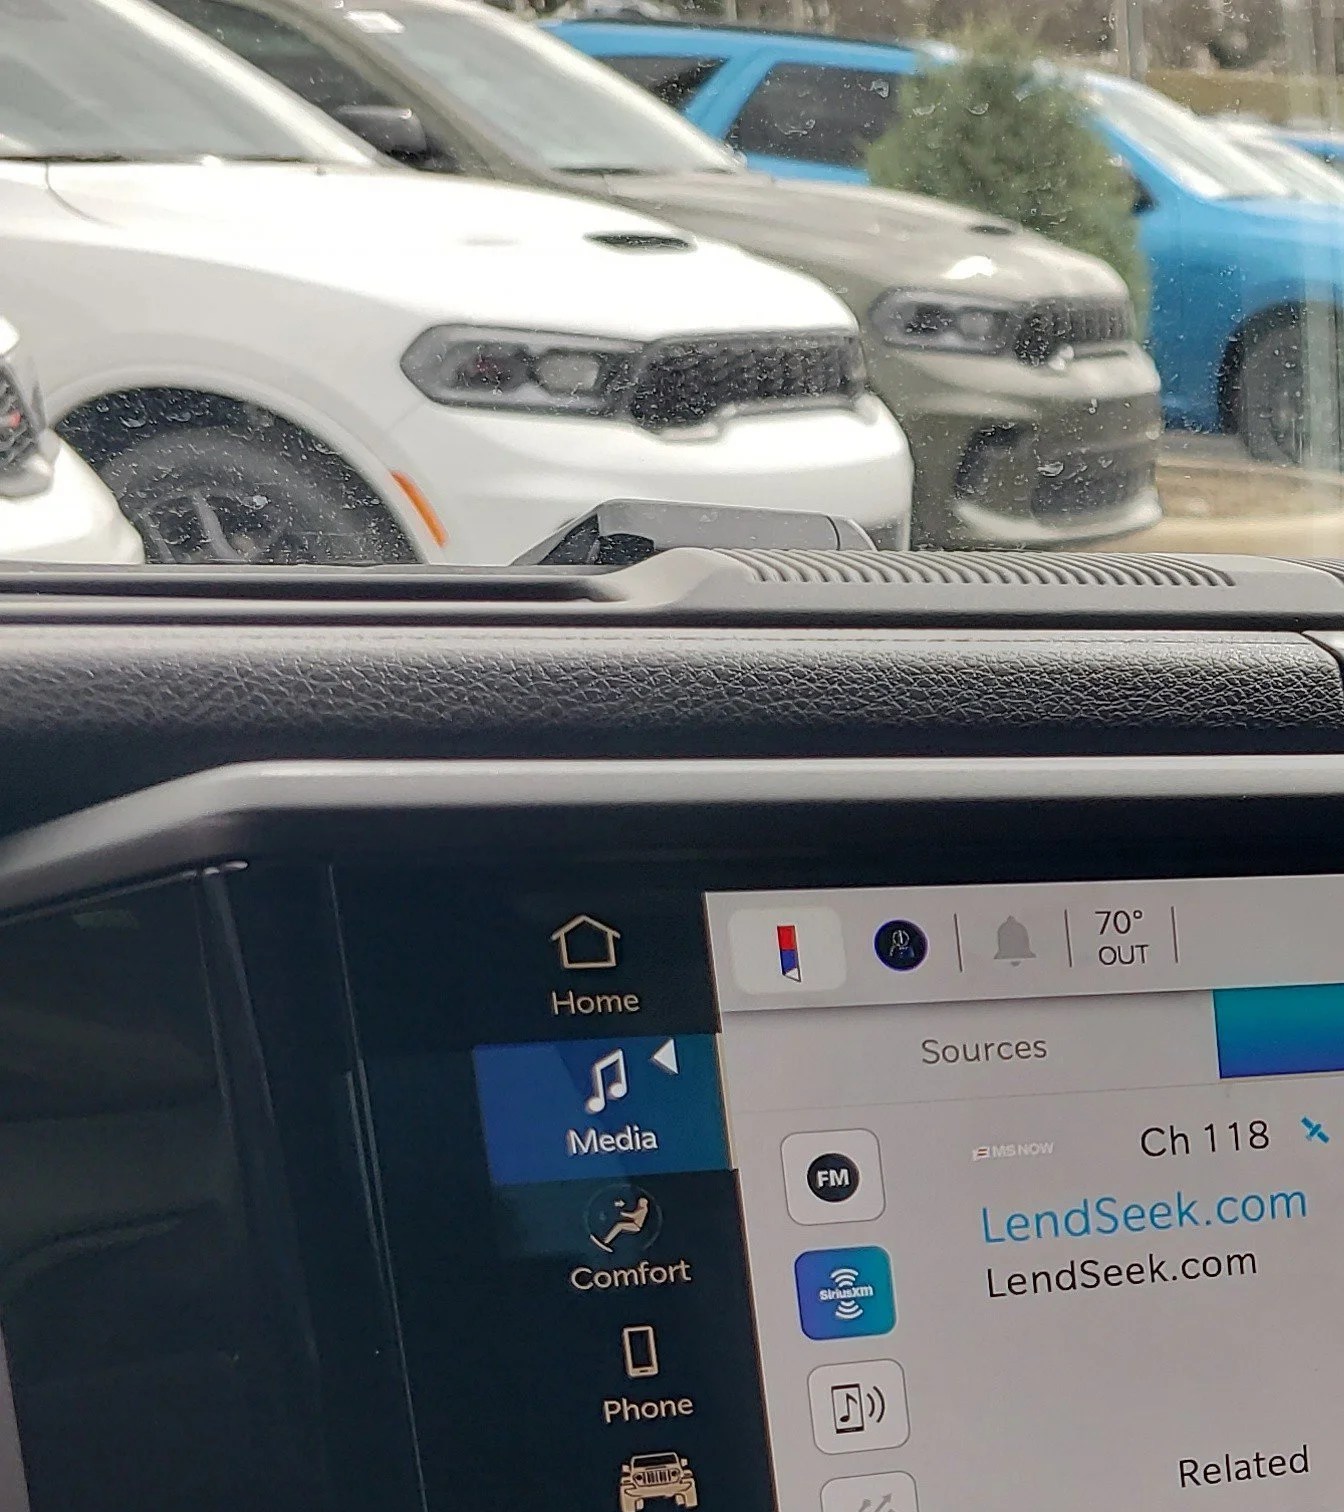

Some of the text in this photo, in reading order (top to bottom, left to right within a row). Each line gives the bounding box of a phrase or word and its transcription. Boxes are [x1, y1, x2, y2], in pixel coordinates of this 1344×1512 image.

[1095, 909, 1144, 936] 70°
[1098, 943, 1149, 967] OUT
[552, 989, 640, 1015] Home
[920, 1036, 1048, 1066] Sources
[567, 1127, 658, 1154] Media
[1139, 1119, 1270, 1159] Ch 118
[816, 1166, 850, 1189] FM
[981, 1187, 1307, 1244] LendSeek.com
[570, 1258, 691, 1290] Comfort
[987, 1248, 1257, 1299] LendSeek.com
[602, 1392, 693, 1424] Phone
[1178, 1444, 1310, 1488] Related
